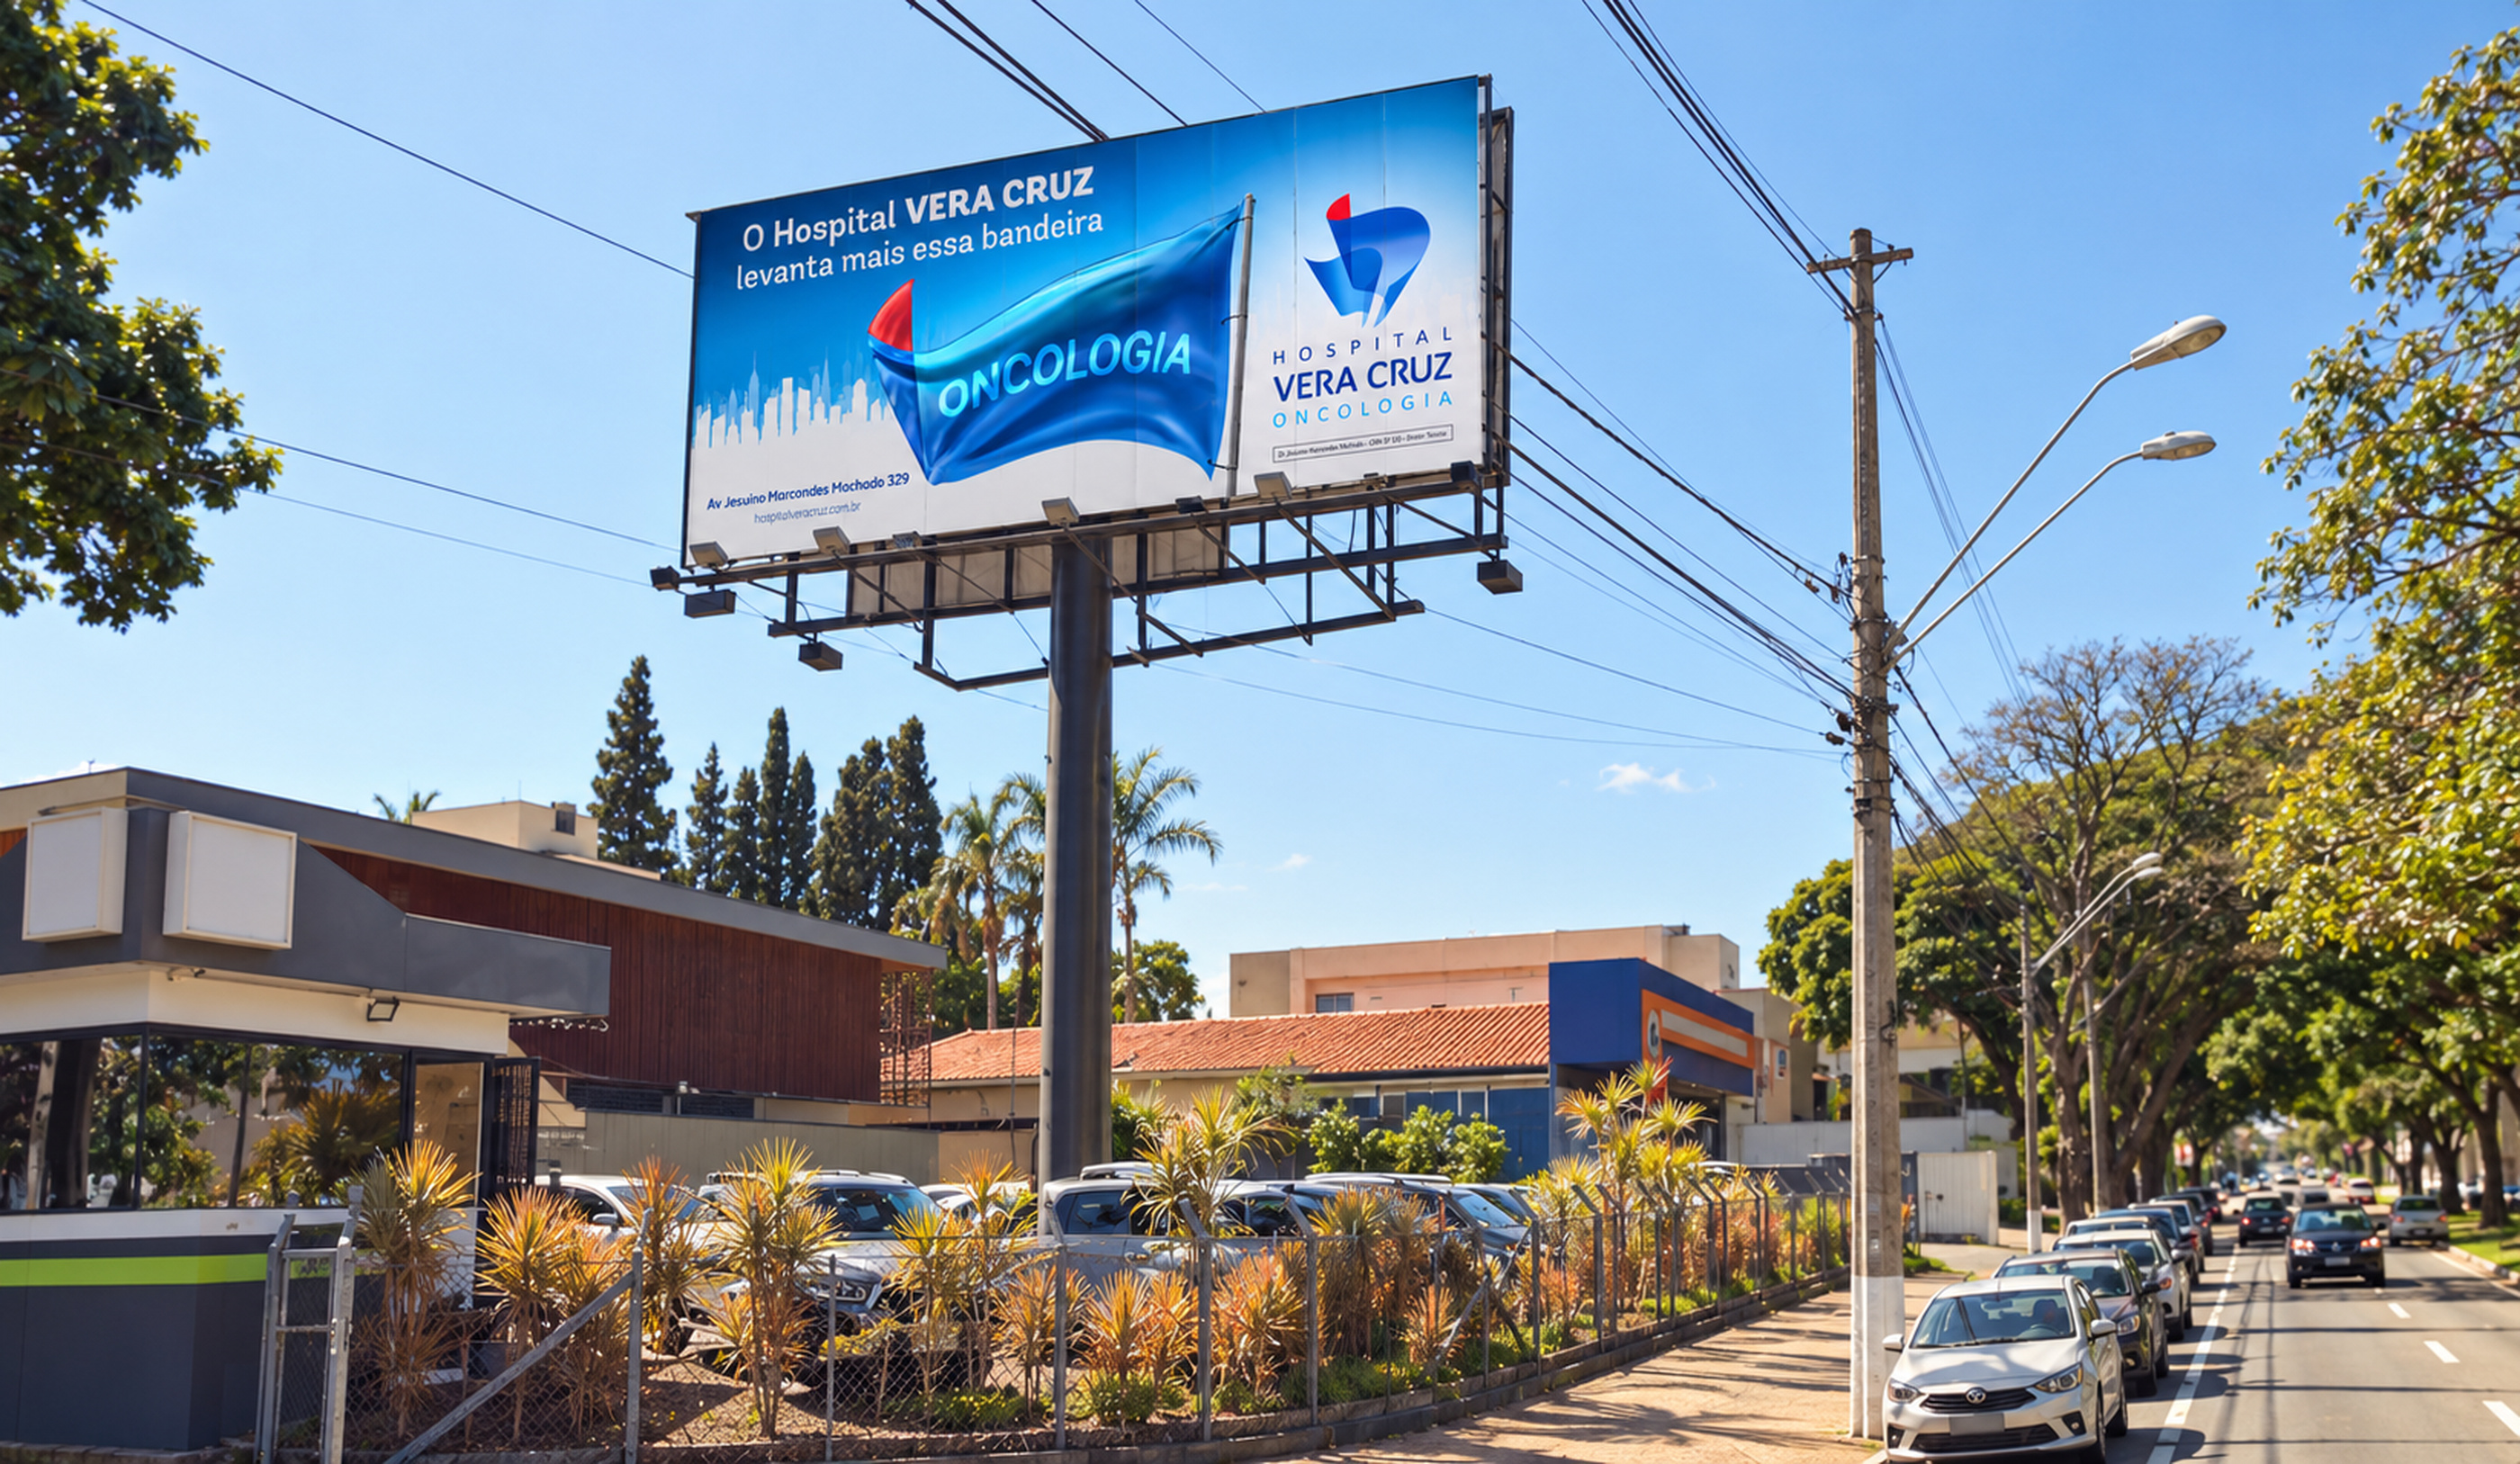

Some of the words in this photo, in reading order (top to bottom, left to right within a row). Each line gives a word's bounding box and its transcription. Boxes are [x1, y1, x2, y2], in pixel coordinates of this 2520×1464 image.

[742, 224, 765, 251] O
[773, 201, 896, 248] Hospital
[904, 185, 994, 225] VERA
[1003, 166, 1094, 209] CRUZ
[736, 259, 834, 290] levanta
[842, 239, 904, 274] mais
[913, 230, 975, 263] essa
[982, 211, 1103, 250] bandeira
[1273, 327, 1452, 365] HOSPITAL
[938, 329, 1191, 418] ONCOLOGIA
[1274, 366, 1357, 402] VERA
[1367, 352, 1452, 389] CRUZ
[1273, 391, 1453, 428] ONCOLOGIA
[706, 498, 723, 510] Av
[768, 485, 830, 503] Marcondes
[887, 472, 910, 487] 329
